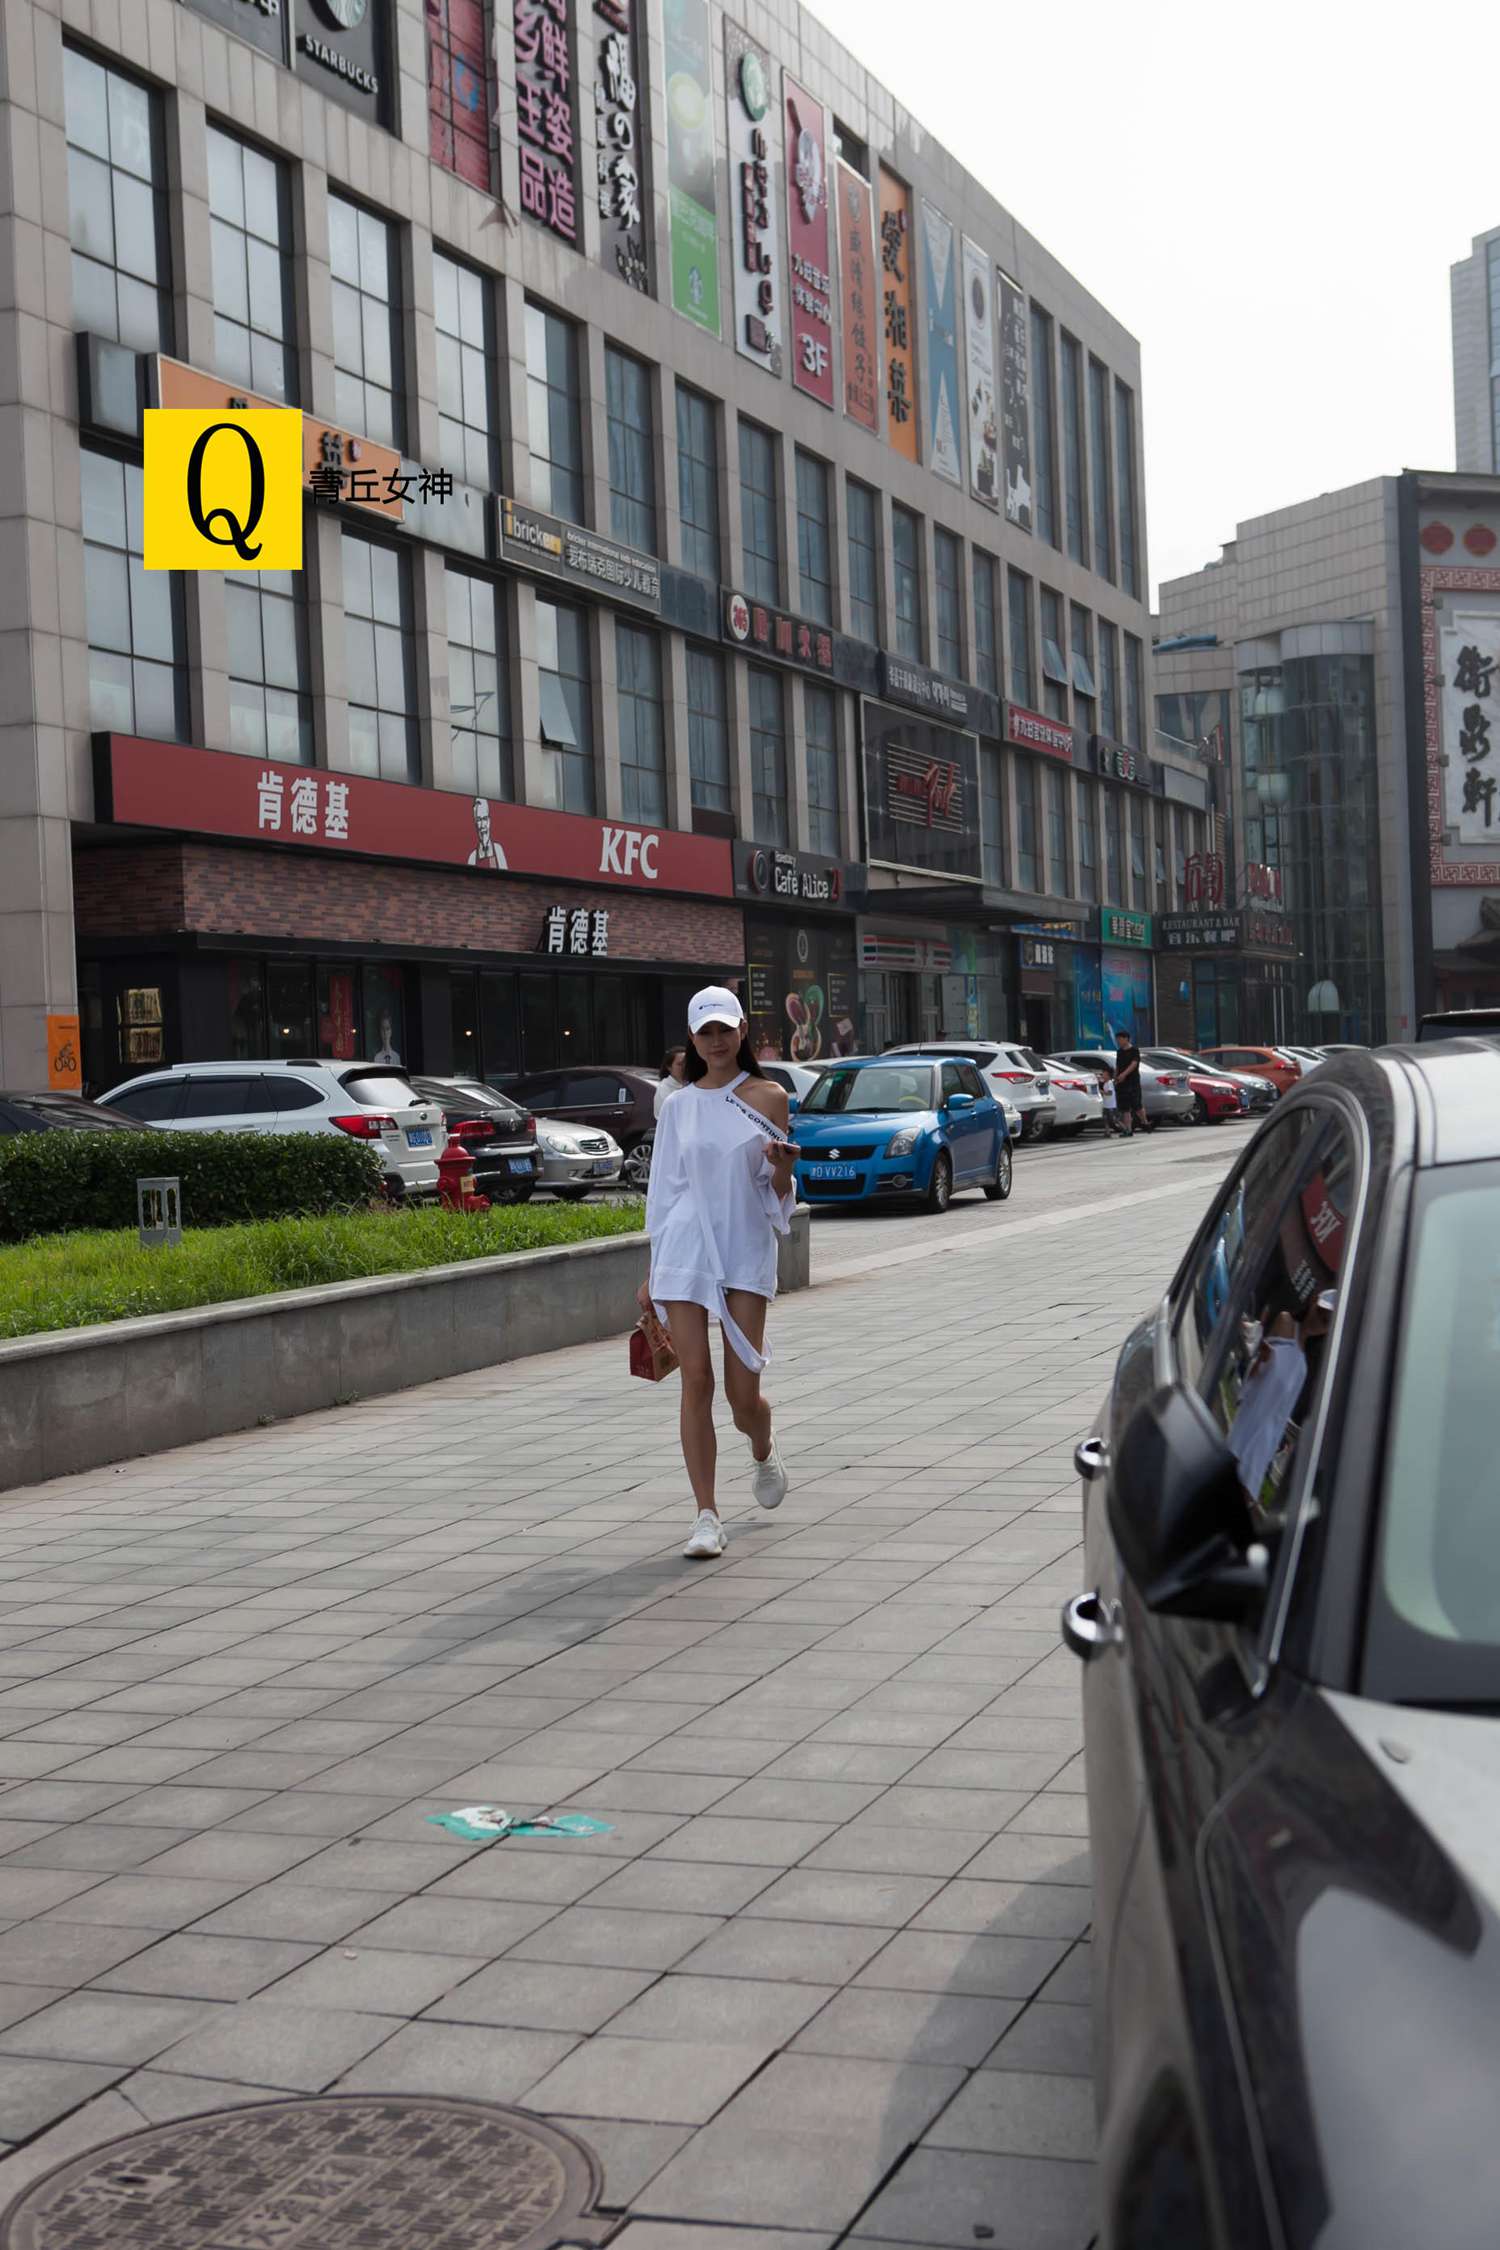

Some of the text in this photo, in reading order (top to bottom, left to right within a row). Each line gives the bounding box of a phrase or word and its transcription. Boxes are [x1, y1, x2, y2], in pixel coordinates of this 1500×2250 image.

[305, 35, 378, 93] STARBUCKS
[541, 0, 576, 239] 鲜姿造
[801, 333, 828, 377] 3F
[257, 770, 350, 840] 肯德基
[600, 826, 660, 880] KFC
[775, 867, 798, 896] Café
[803, 872, 829, 899] Alice
[547, 906, 609, 956] 肯德基
